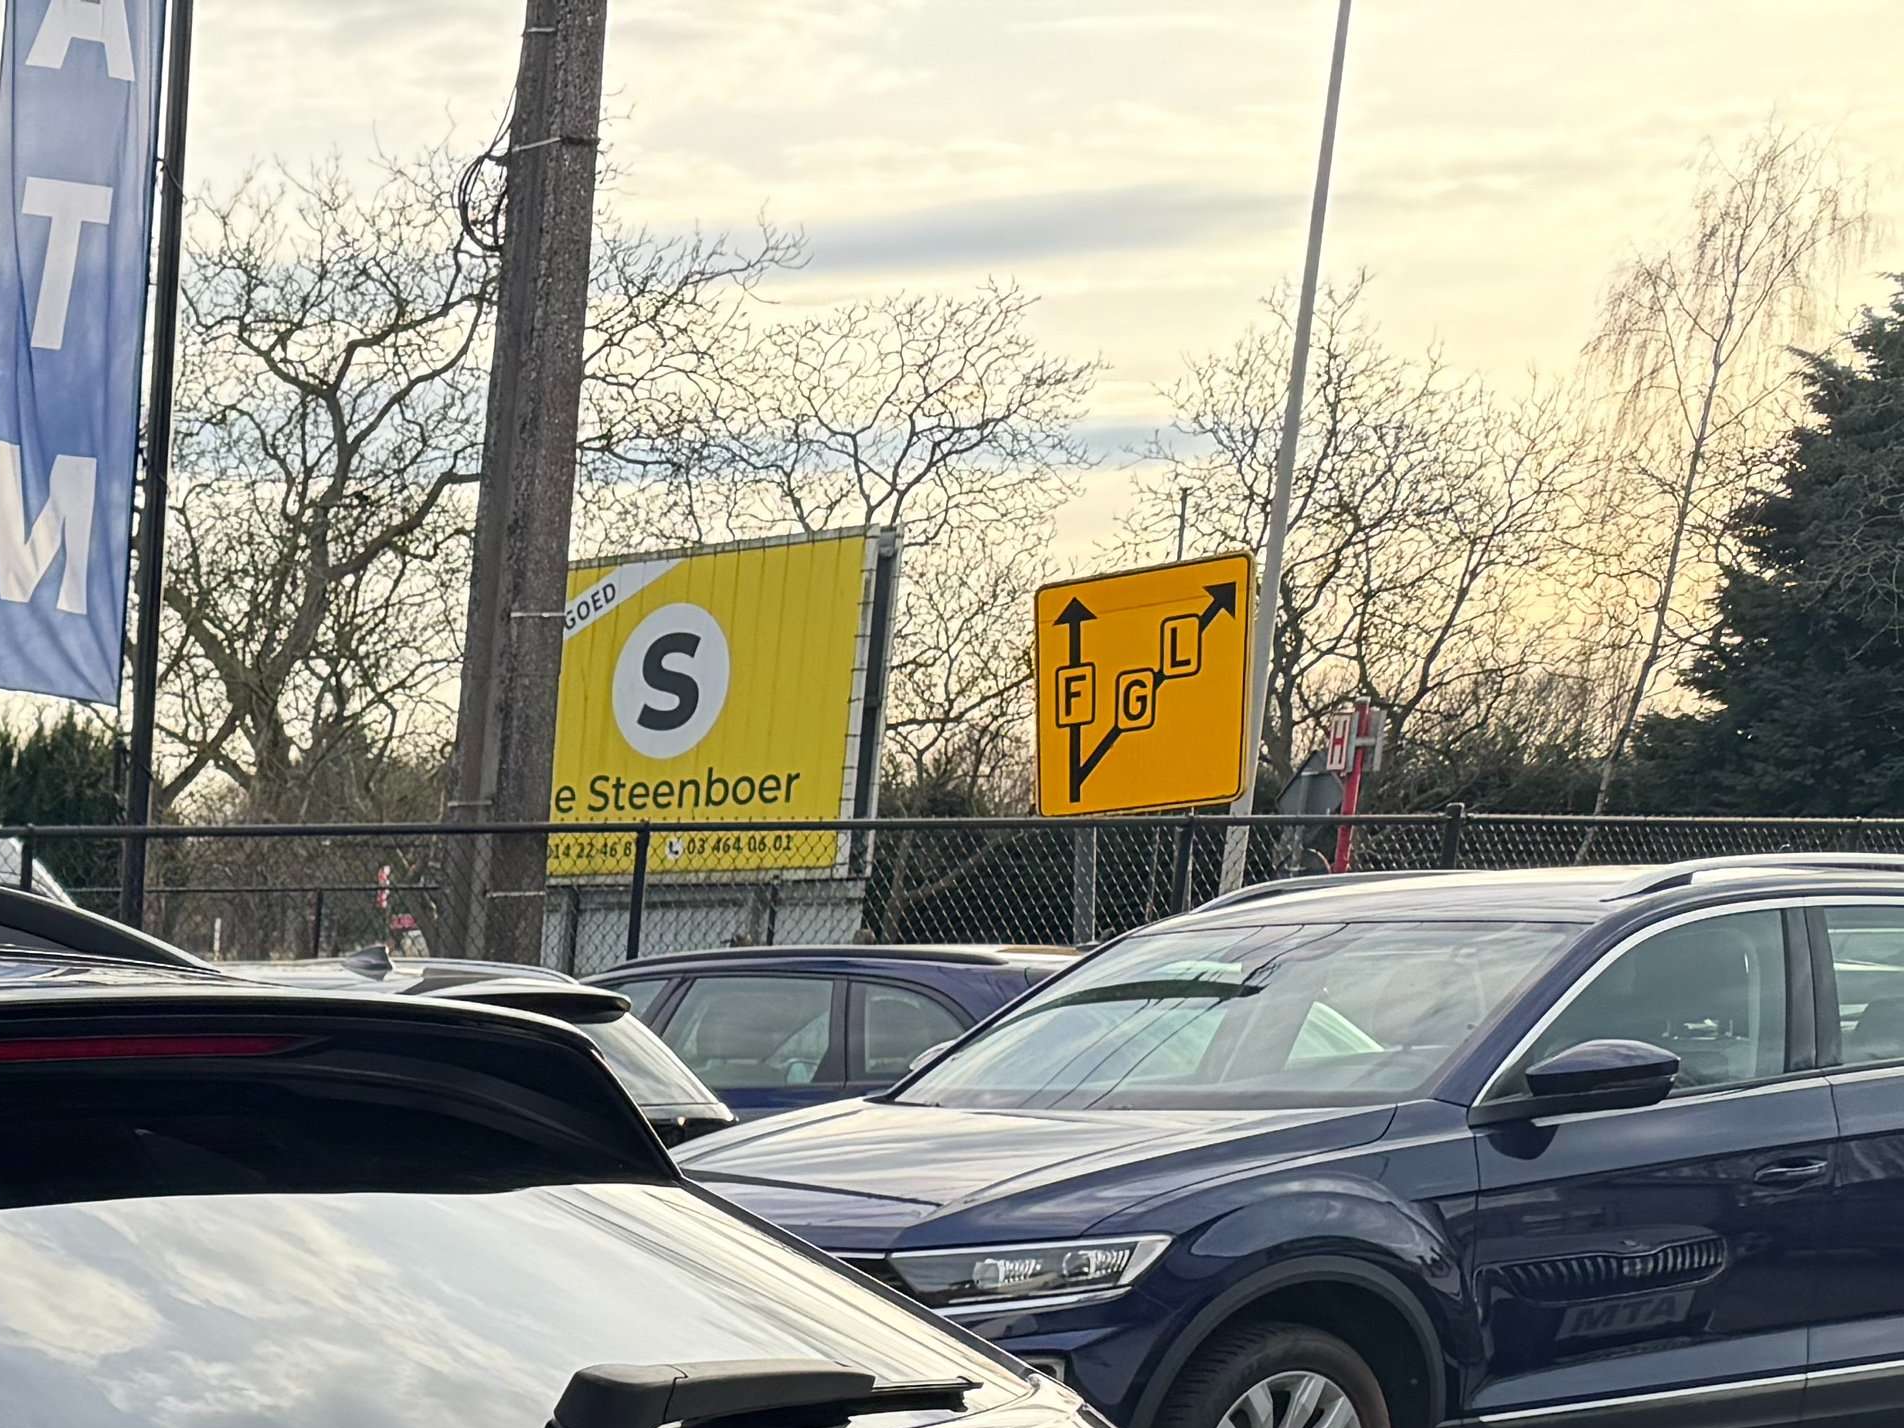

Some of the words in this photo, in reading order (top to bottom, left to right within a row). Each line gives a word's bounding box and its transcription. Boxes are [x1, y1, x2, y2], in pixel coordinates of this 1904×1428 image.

[1170, 627, 1191, 668] L
[637, 632, 702, 731] S
[1064, 674, 1087, 717] F
[1122, 680, 1148, 721] G
[587, 767, 800, 813] Steenboer
[687, 838, 706, 855] 03
